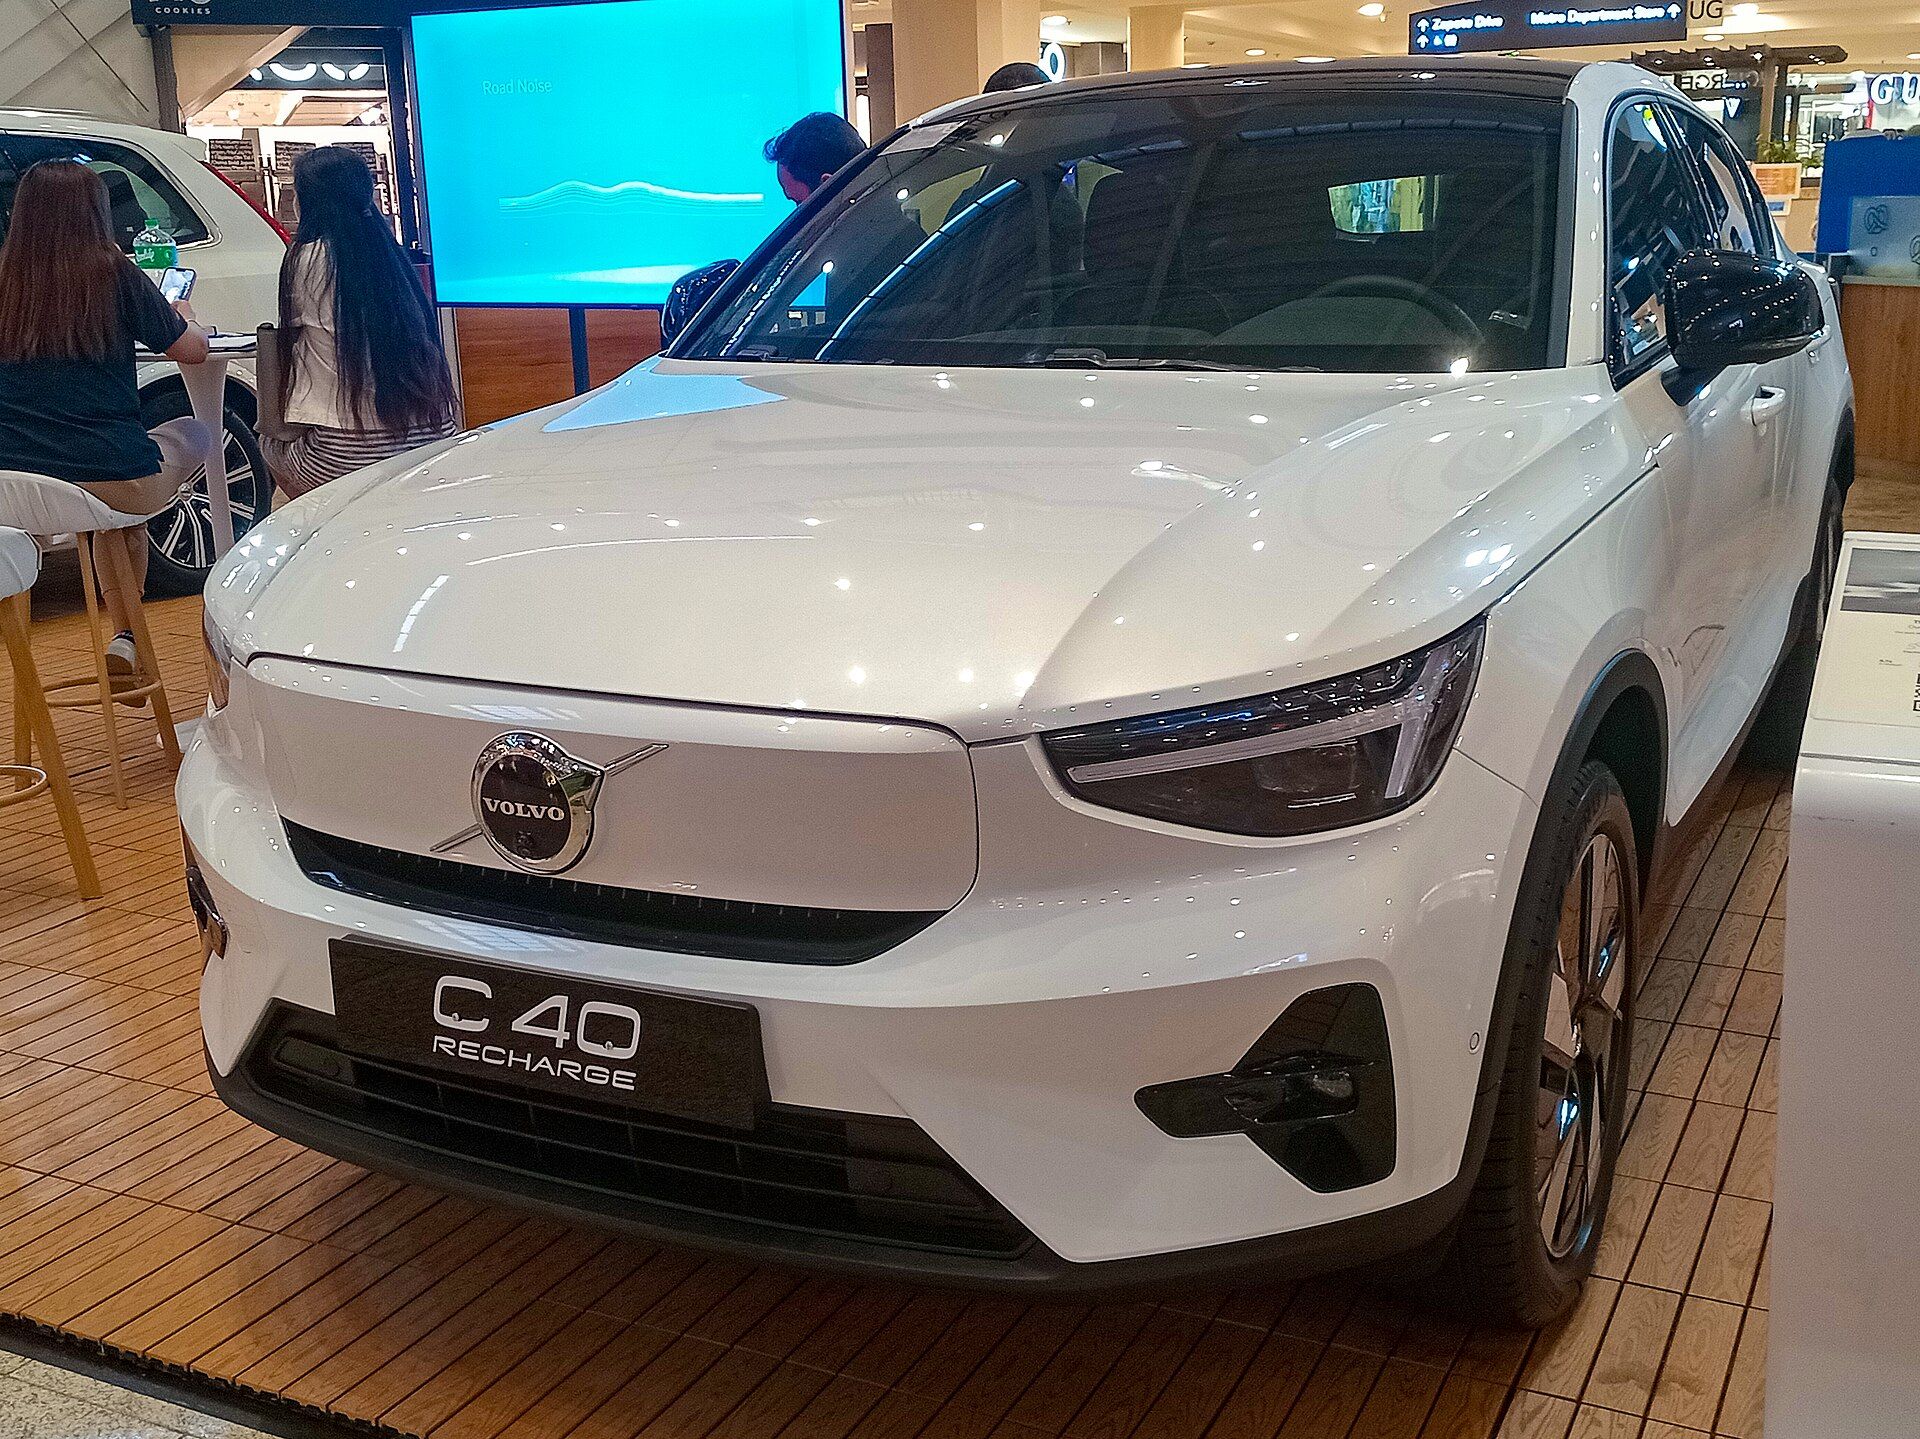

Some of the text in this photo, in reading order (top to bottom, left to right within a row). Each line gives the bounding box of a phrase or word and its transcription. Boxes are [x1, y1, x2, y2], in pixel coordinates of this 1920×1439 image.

[154, 7, 212, 15] COOKIES
[1567, 8, 1633, 25] Department
[1690, 0, 1723, 19] UG
[482, 78, 553, 96] Road Noise
[481, 796, 565, 821] VOLVO
[432, 1034, 638, 1091] RECHARGE
